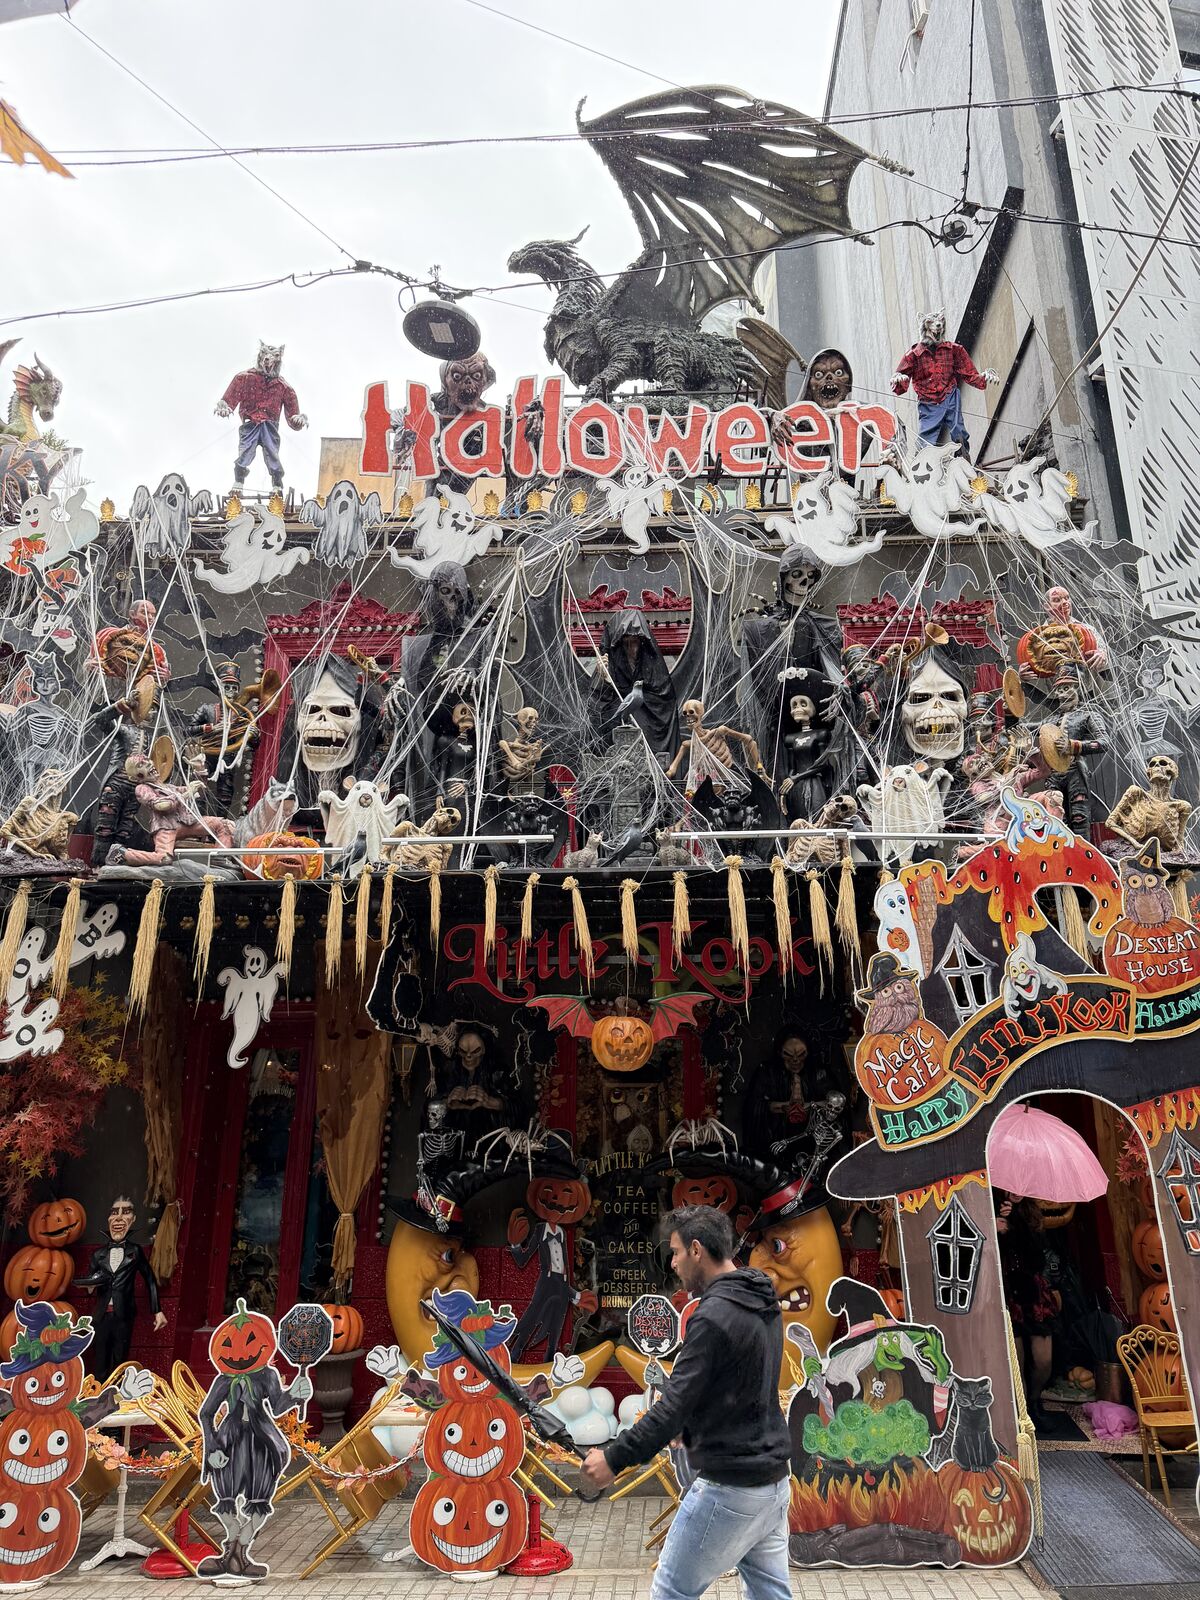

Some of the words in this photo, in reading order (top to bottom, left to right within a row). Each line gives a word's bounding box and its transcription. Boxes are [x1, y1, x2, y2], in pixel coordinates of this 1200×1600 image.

[358, 374, 898, 480] Halloween
[1111, 929, 1198, 957] DESSERT
[443, 920, 609, 1004] Little
[637, 917, 816, 1004] Kook
[1126, 957, 1194, 983] HOUSE
[1040, 992, 1131, 1036] KOOK
[593, 1151, 634, 1177] LITTLE
[615, 1185, 645, 1197] TEA
[603, 1202, 657, 1215] COFFEE
[623, 1222, 640, 1235] AND
[608, 1241, 653, 1254] CAKES
[613, 1269, 647, 1281] GREEK
[603, 1282, 657, 1294] DESSERTS
[601, 1295, 633, 1309] BRUNCH
[634, 1314, 671, 1329] DESSERT
